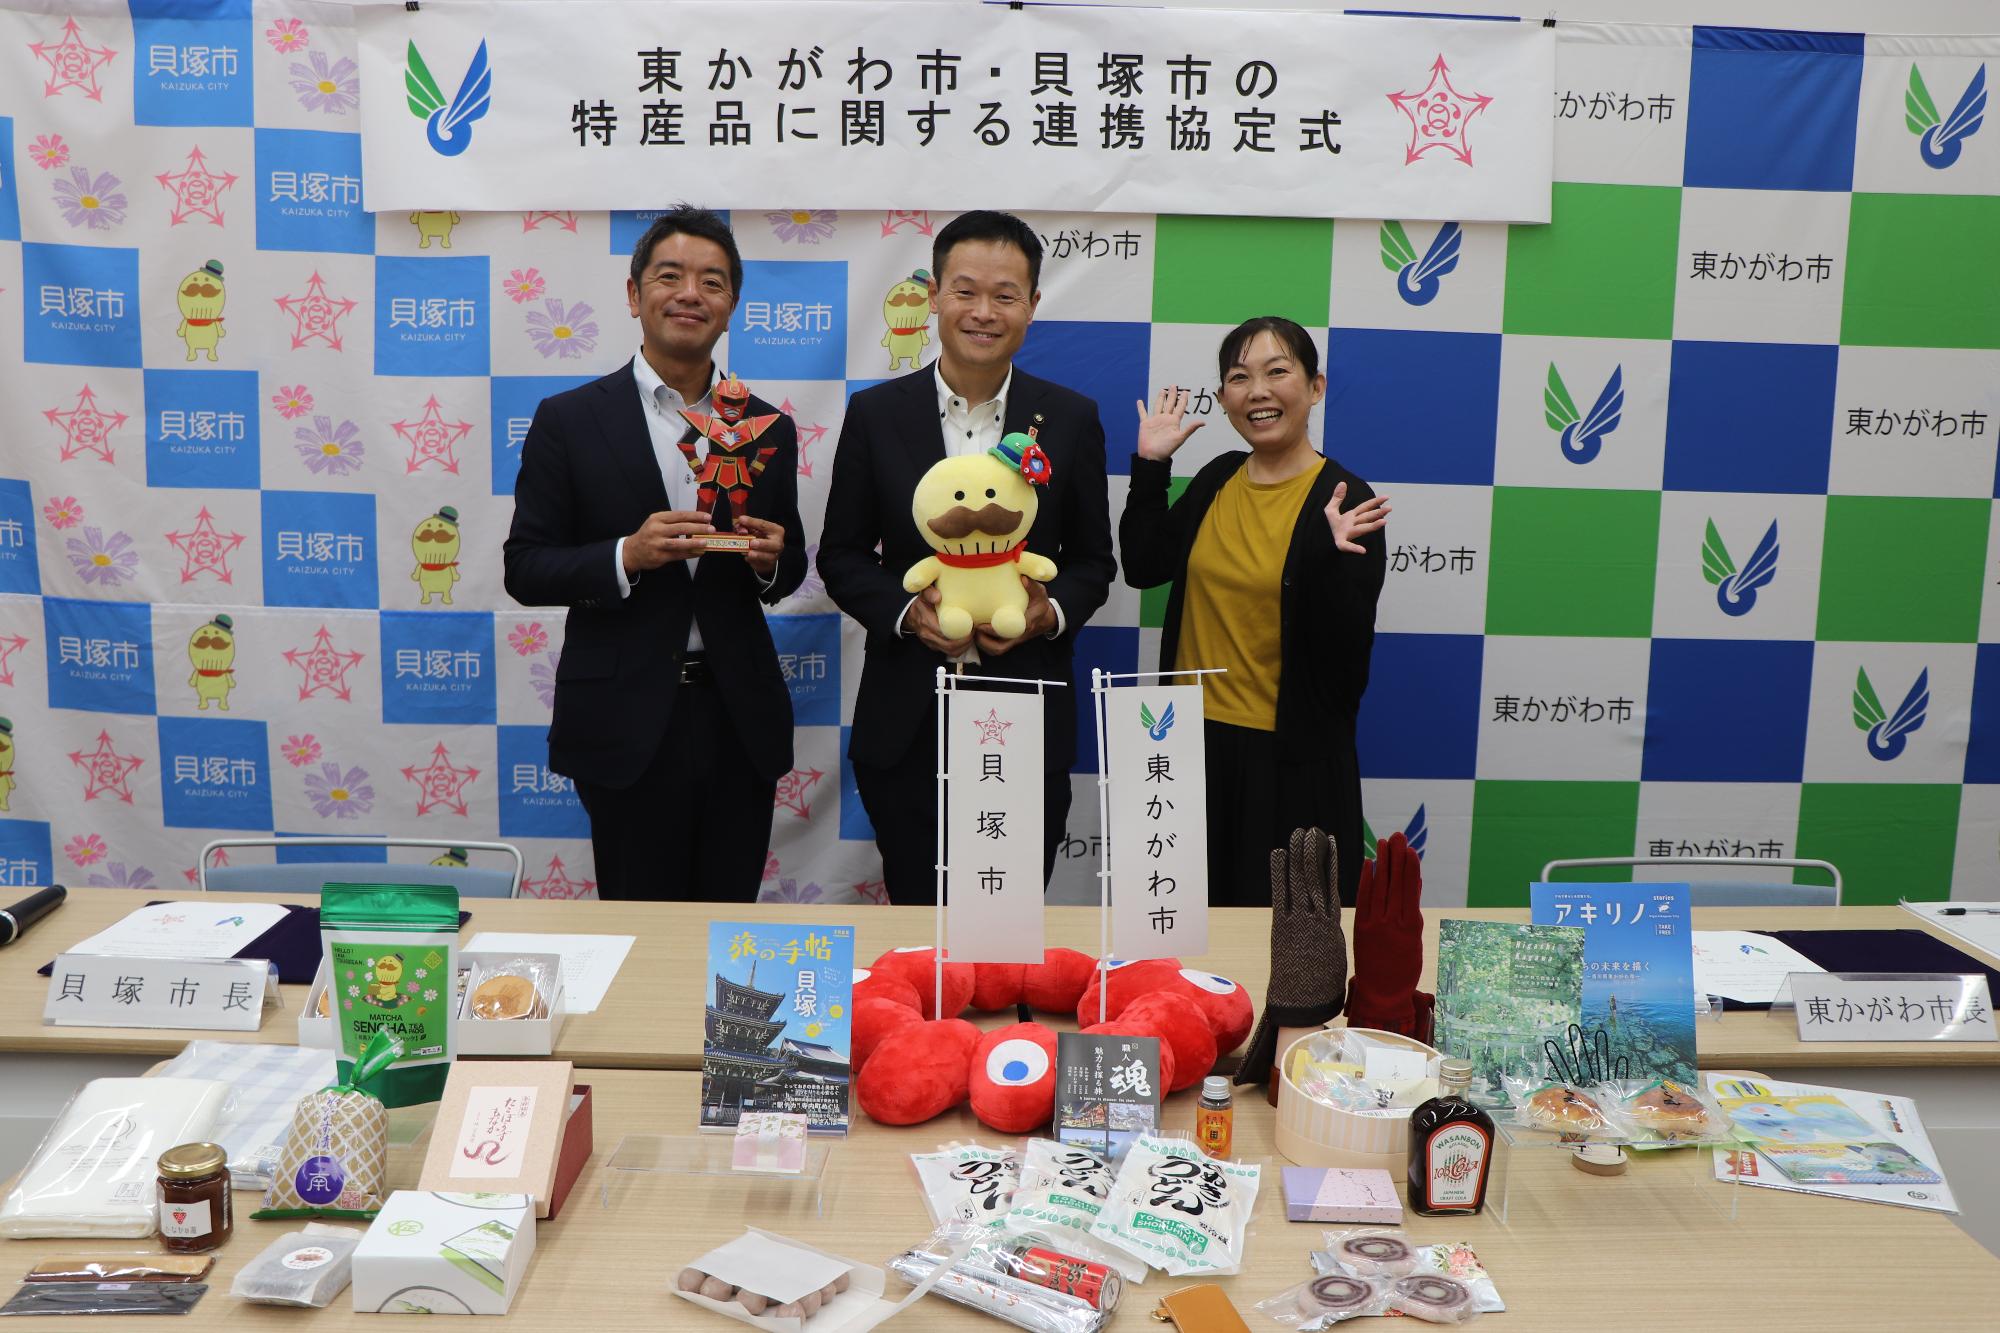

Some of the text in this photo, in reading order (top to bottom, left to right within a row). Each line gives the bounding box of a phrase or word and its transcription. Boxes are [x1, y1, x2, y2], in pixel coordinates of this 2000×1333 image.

[149, 45, 238, 76] 貝塚市
[638, 46, 1277, 98] 東かがわ市・貝塚市の
[1554, 91, 1675, 123] かがわ市
[572, 98, 1341, 154] 特産品に関する連携協定式
[271, 172, 360, 204] 貝塚市
[282, 208, 323, 216] KAIZUKA
[1691, 251, 1833, 283] 東かがわ市
[40, 286, 124, 319] 貝塚市
[390, 298, 475, 328] 貝塚市
[744, 302, 832, 332] 貝塚市
[52, 322, 115, 332] KAIZUKA CITY
[444, 333, 465, 341] CITY
[160, 411, 244, 440] 貝塚市
[1846, 408, 1987, 438] 東かがわ市
[277, 532, 363, 562] 貝塚市
[288, 566, 328, 574] KAIZUKA
[60, 637, 138, 668] 貝塚市
[396, 650, 480, 678] 貝塚市
[71, 671, 107, 679] KAIZUKA
[1493, 695, 1633, 724] 東かがわ市
[175, 756, 255, 785] 貝塚市
[512, 764, 573, 795] 貝塚
[223, 790, 248, 798] CITY
[977, 754, 1006, 895] 貝塚市
[1145, 754, 1177, 934] 東かがわ市
[1554, 901, 1646, 926] アキリノ
[727, 931, 834, 965] 旅の手帖
[55, 972, 254, 1013] 貝塚市長
[793, 969, 817, 1018] 貝塚
[1804, 993, 1988, 1026] 東かがわ市長
[1109, 1059, 1152, 1097] 魂
[1149, 1155, 1204, 1216] うどん
